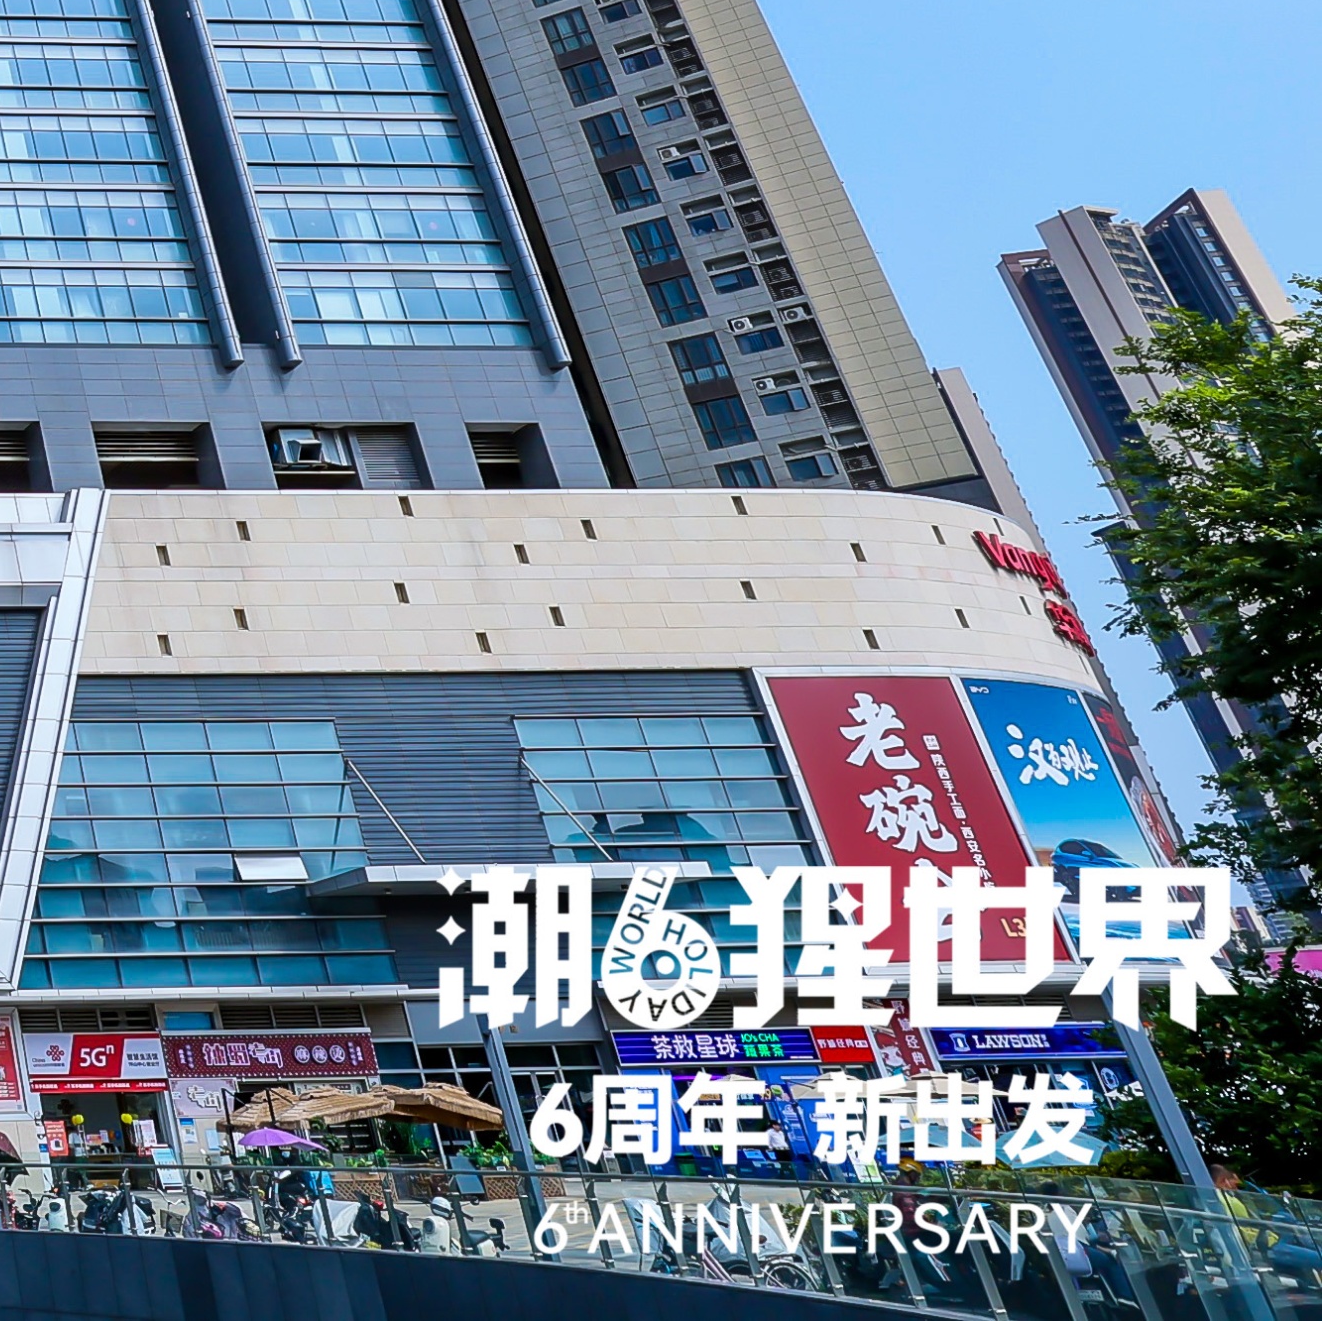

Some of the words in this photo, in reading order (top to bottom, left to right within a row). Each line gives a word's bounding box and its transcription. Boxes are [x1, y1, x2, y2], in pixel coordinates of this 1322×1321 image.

[758, 1033, 779, 1042] CHA
[651, 1034, 739, 1060] 茶救星球
